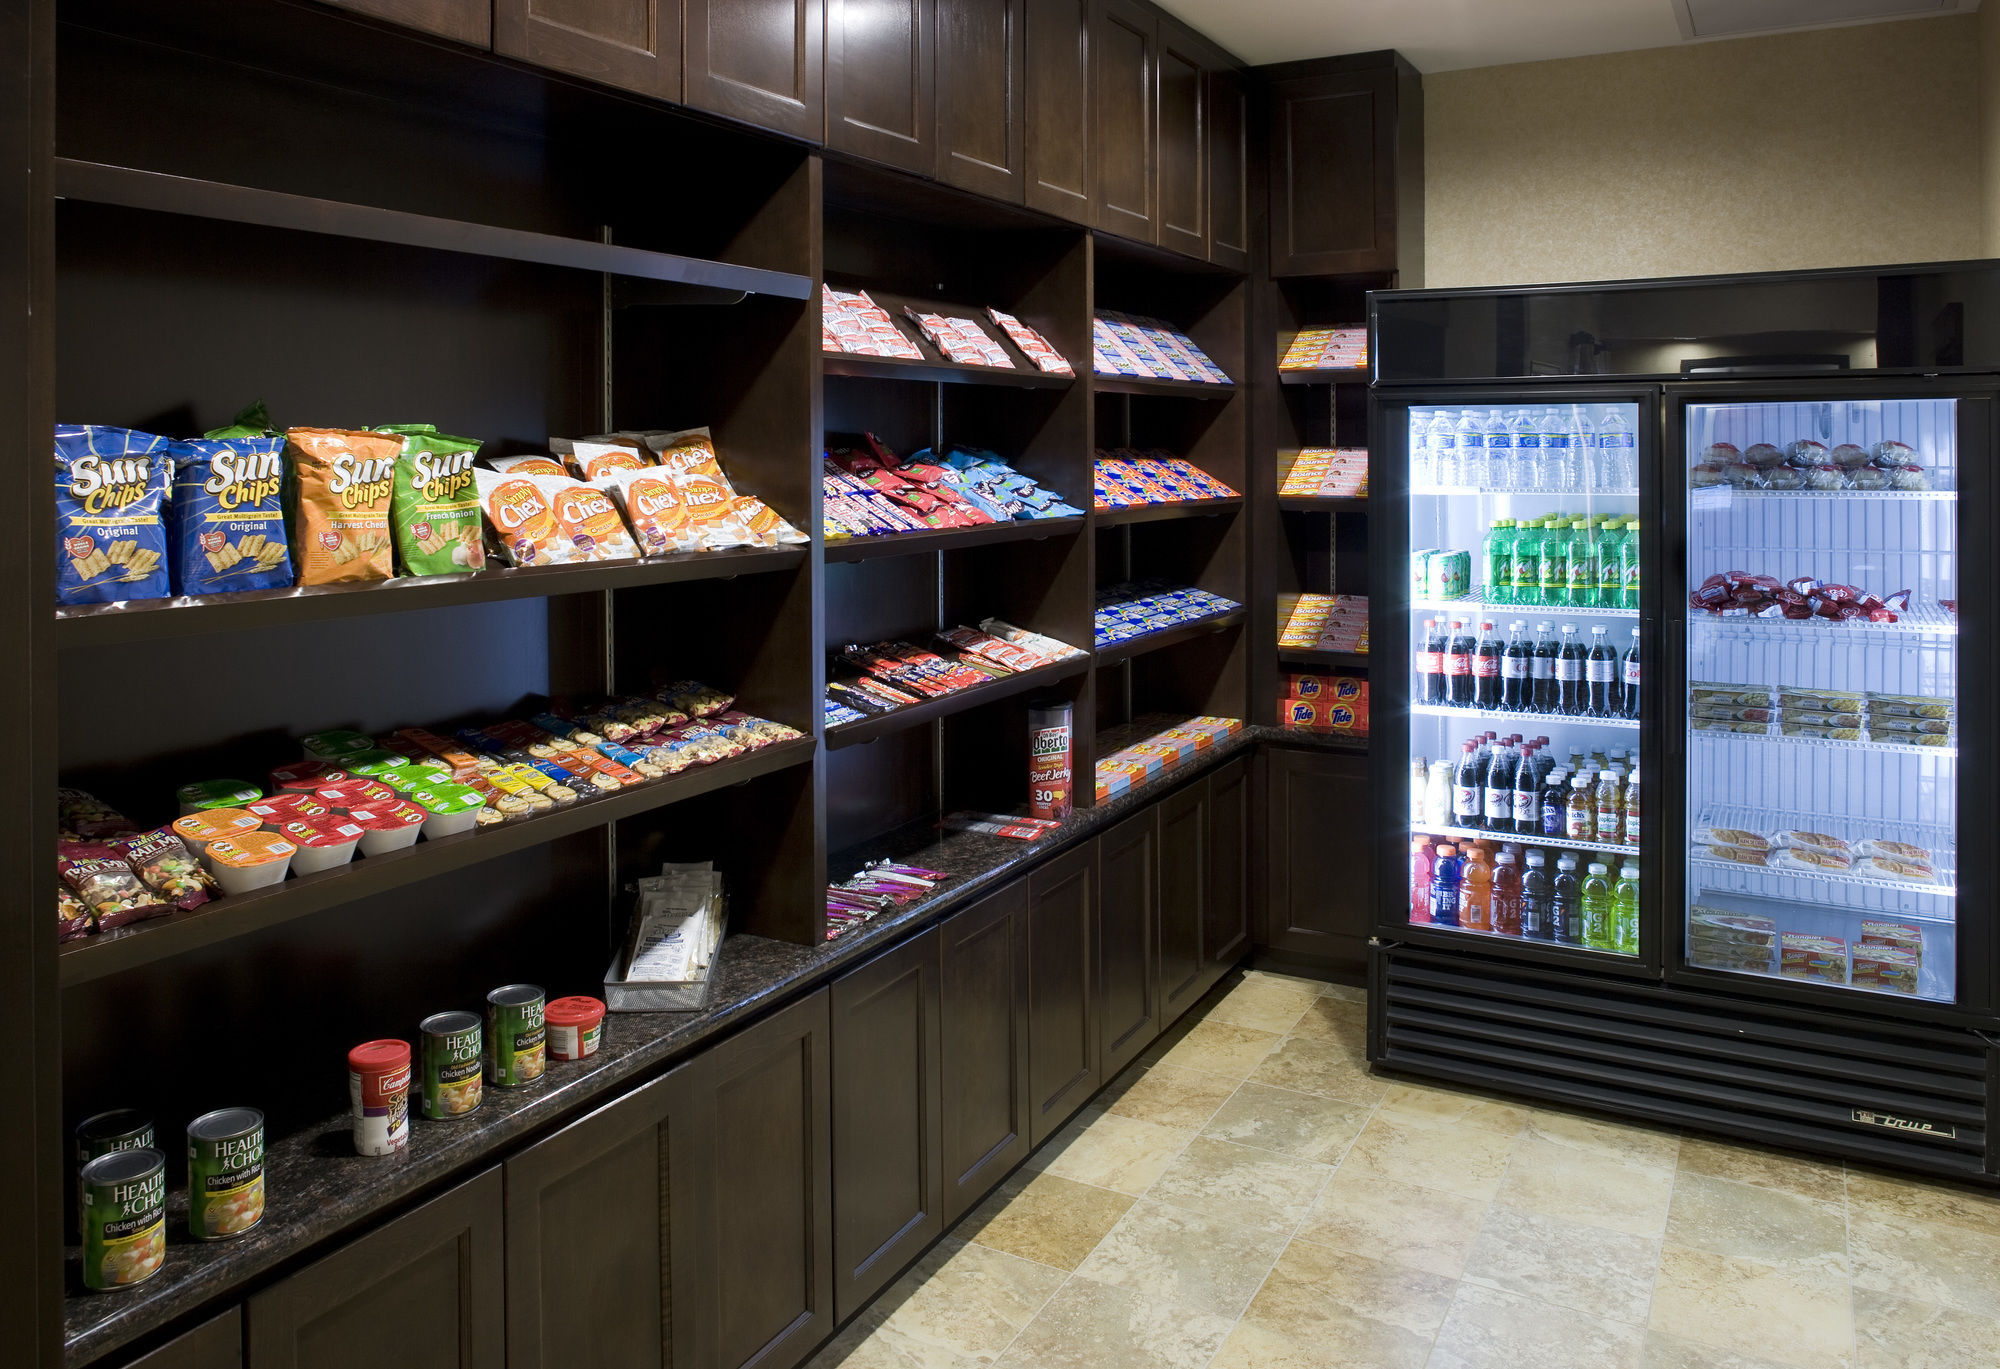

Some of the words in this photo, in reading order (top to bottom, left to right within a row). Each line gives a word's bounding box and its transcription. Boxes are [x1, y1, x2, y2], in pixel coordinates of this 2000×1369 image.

[671, 448, 713, 471] Chex
[70, 455, 150, 497] Sun
[205, 451, 280, 494] Sun
[329, 453, 394, 493] Sun
[411, 451, 474, 489] Sun
[219, 477, 279, 509] Chips
[422, 470, 472, 502] Chips
[643, 483, 667, 496] Simply
[84, 481, 147, 514] Chips
[341, 480, 390, 509] Chips
[504, 486, 533, 503] Simply
[500, 495, 546, 528] Chex
[563, 497, 615, 524] Chex
[637, 492, 679, 516] Chex
[426, 512, 450, 521] French
[449, 510, 475, 519] Onion
[96, 526, 139, 538] Original
[229, 521, 268, 533] Original
[331, 521, 364, 529] Harvest
[1283, 633, 1317, 641] Bounce
[1300, 680, 1319, 696] Tide
[1338, 682, 1358, 698] Tide
[1294, 706, 1314, 722] Tide
[1332, 709, 1352, 725] Tide
[1033, 734, 1068, 750] Oberto
[1037, 754, 1064, 763] ORIGINAL
[1030, 770, 1051, 783] Beef
[1050, 767, 1071, 783] Jerky
[1035, 789, 1053, 802] 30
[128, 831, 166, 849] PLANTERS
[125, 839, 161, 865] TRAIL
[1509, 899, 1517, 909] G
[1509, 909, 1517, 919] 2
[1593, 912, 1603, 923] G
[1593, 922, 1603, 933] 2
[1787, 933, 1822, 941] Banquet
[1786, 952, 1808, 960] Banquet
[1857, 963, 1879, 971] Banquet
[516, 1035, 539, 1047] Chicken
[441, 1067, 466, 1079] Chicken
[390, 1119, 401, 1132] 70
[1883, 1116, 1933, 1131] true
[215, 1126, 264, 1158] HEALTH
[207, 1174, 236, 1187] Chicken
[236, 1168, 251, 1181] with
[251, 1163, 261, 1175] Rice
[113, 1166, 165, 1203] HEALTH
[105, 1220, 137, 1234] Chicken
[137, 1212, 153, 1226] with
[152, 1206, 163, 1219] Rice
